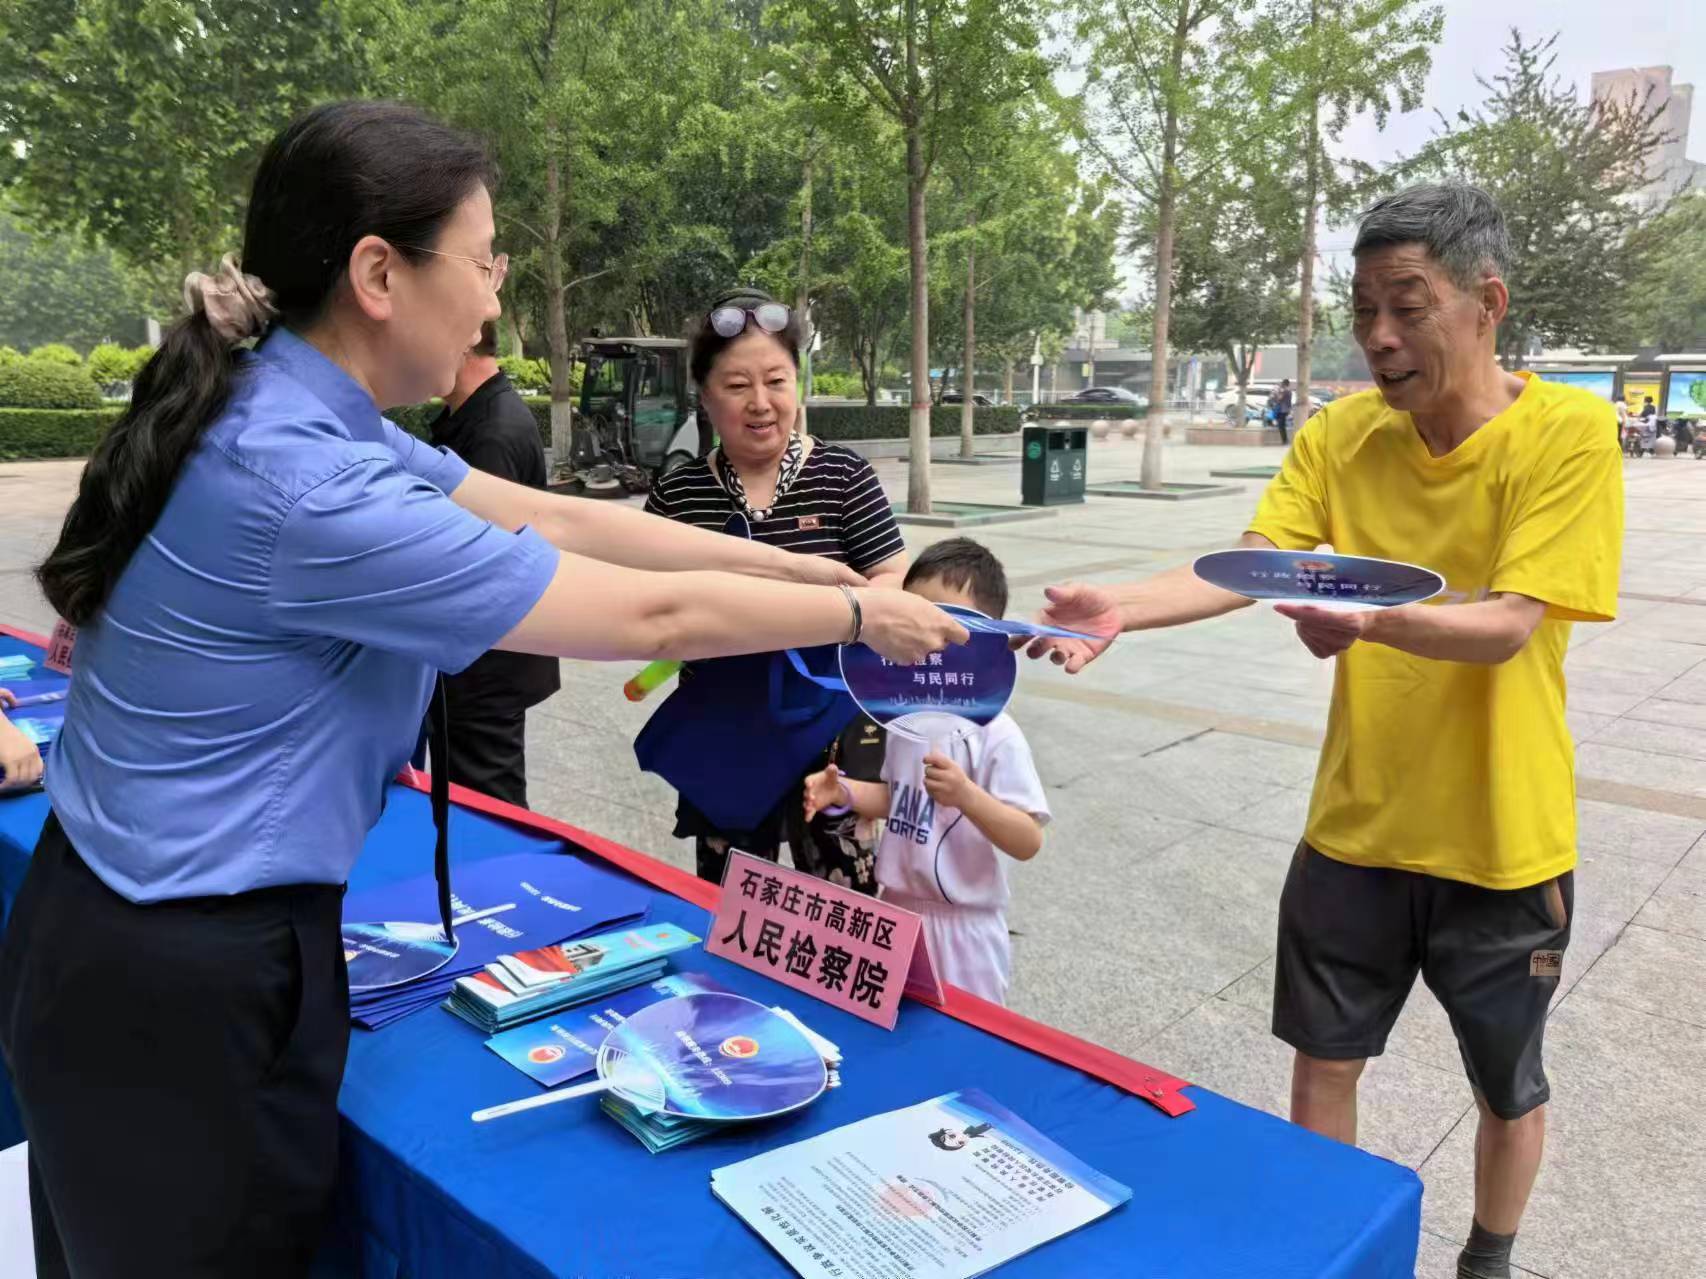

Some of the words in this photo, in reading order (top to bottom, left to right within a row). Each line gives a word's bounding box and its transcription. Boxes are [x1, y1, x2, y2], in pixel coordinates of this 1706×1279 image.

[881, 652, 943, 666] 行察
[913, 671, 974, 686] 与民同行
[894, 782, 935, 829] ANA
[886, 817, 929, 844] ORTS
[740, 868, 897, 951] 石家庄市高新区
[721, 909, 889, 1010] 人民检察院
[761, 1205, 844, 1277] 行政争议实质性化解
